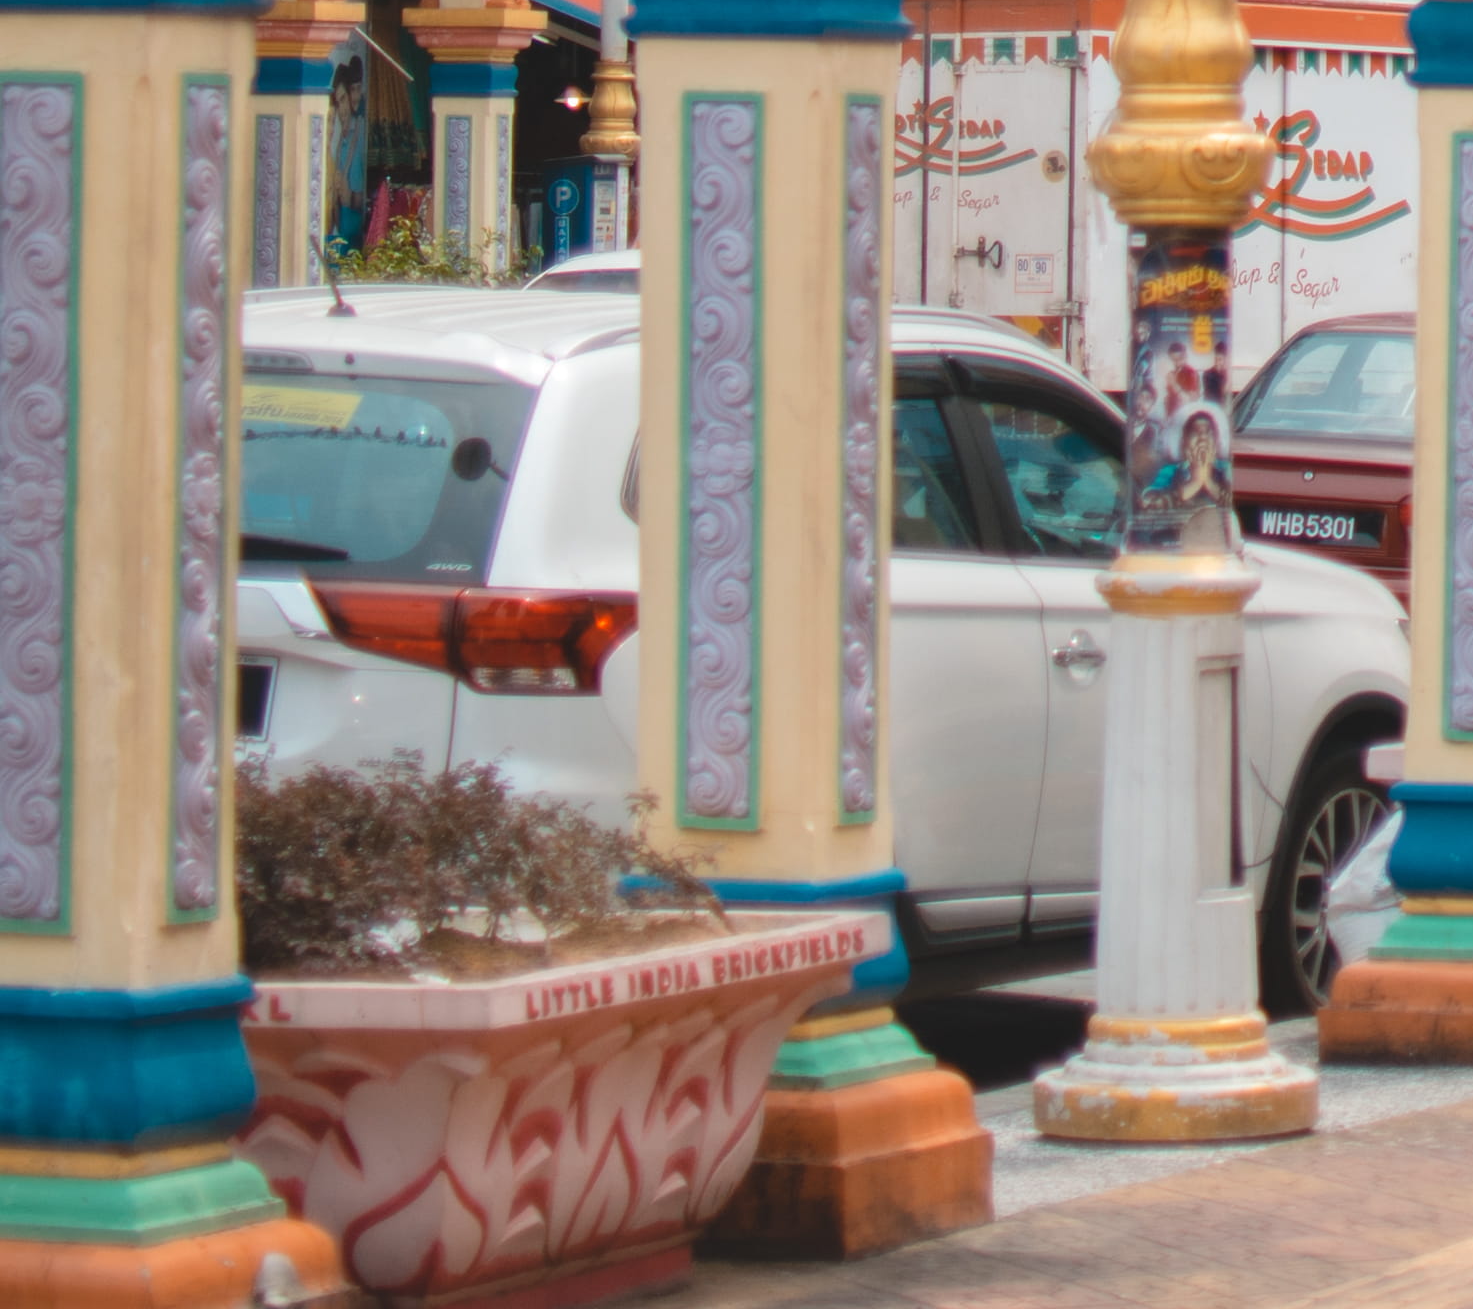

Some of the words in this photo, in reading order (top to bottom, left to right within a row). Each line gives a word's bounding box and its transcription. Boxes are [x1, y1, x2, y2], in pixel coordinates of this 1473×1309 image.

[555, 185, 573, 208] P
[930, 185, 941, 201] &
[957, 189, 1000, 216] Segar
[1017, 258, 1029, 272] 80
[1035, 261, 1047, 274] 90
[1267, 261, 1281, 285] &
[1290, 268, 1340, 310] Segar
[1260, 510, 1356, 541] WHB5301
[425, 563, 473, 572] 4WD
[525, 976, 615, 1021] LITTLE
[627, 960, 701, 999] INDIA
[711, 927, 865, 985] BRICKFIELDS
